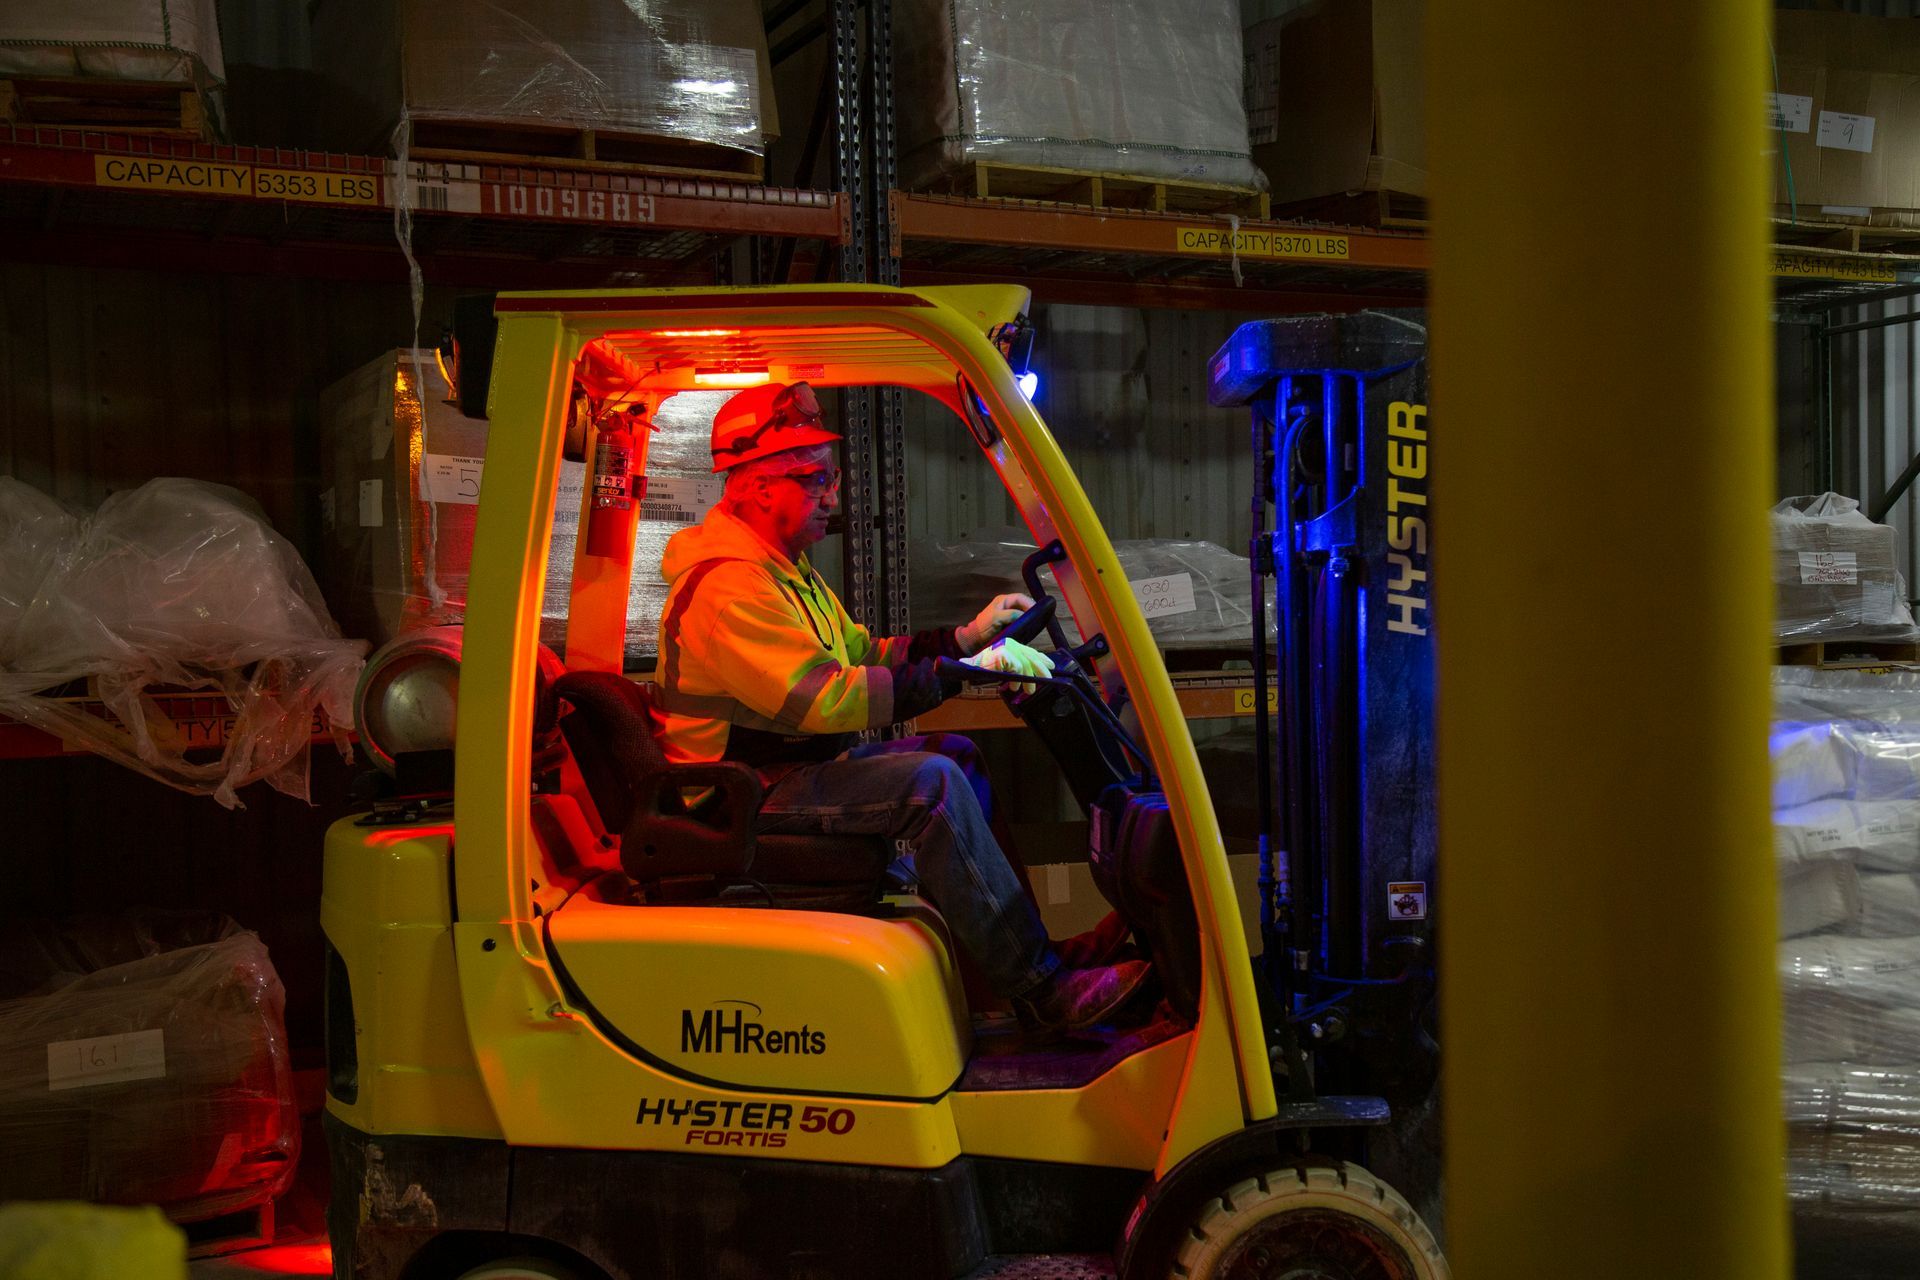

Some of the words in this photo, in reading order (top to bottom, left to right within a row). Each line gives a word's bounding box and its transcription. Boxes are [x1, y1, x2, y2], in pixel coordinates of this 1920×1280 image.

[105, 159, 248, 189] CAPACITY
[257, 173, 317, 196] 5353
[326, 177, 375, 200] LBS
[1183, 231, 1270, 251] CAPACITY
[1274, 236, 1311, 254] 5370
[1316, 239, 1347, 255] LBS
[1870, 264, 1896, 279] LBS
[457, 468, 480, 497] 5
[1387, 401, 1428, 636] HYSTER
[1142, 579, 1170, 595] 030
[681, 1009, 826, 1055] MHRents
[78, 1045, 118, 1072] 161
[636, 1098, 793, 1130] HYSTER
[800, 1105, 855, 1135] 50
[685, 1130, 787, 1148] FORTIS
